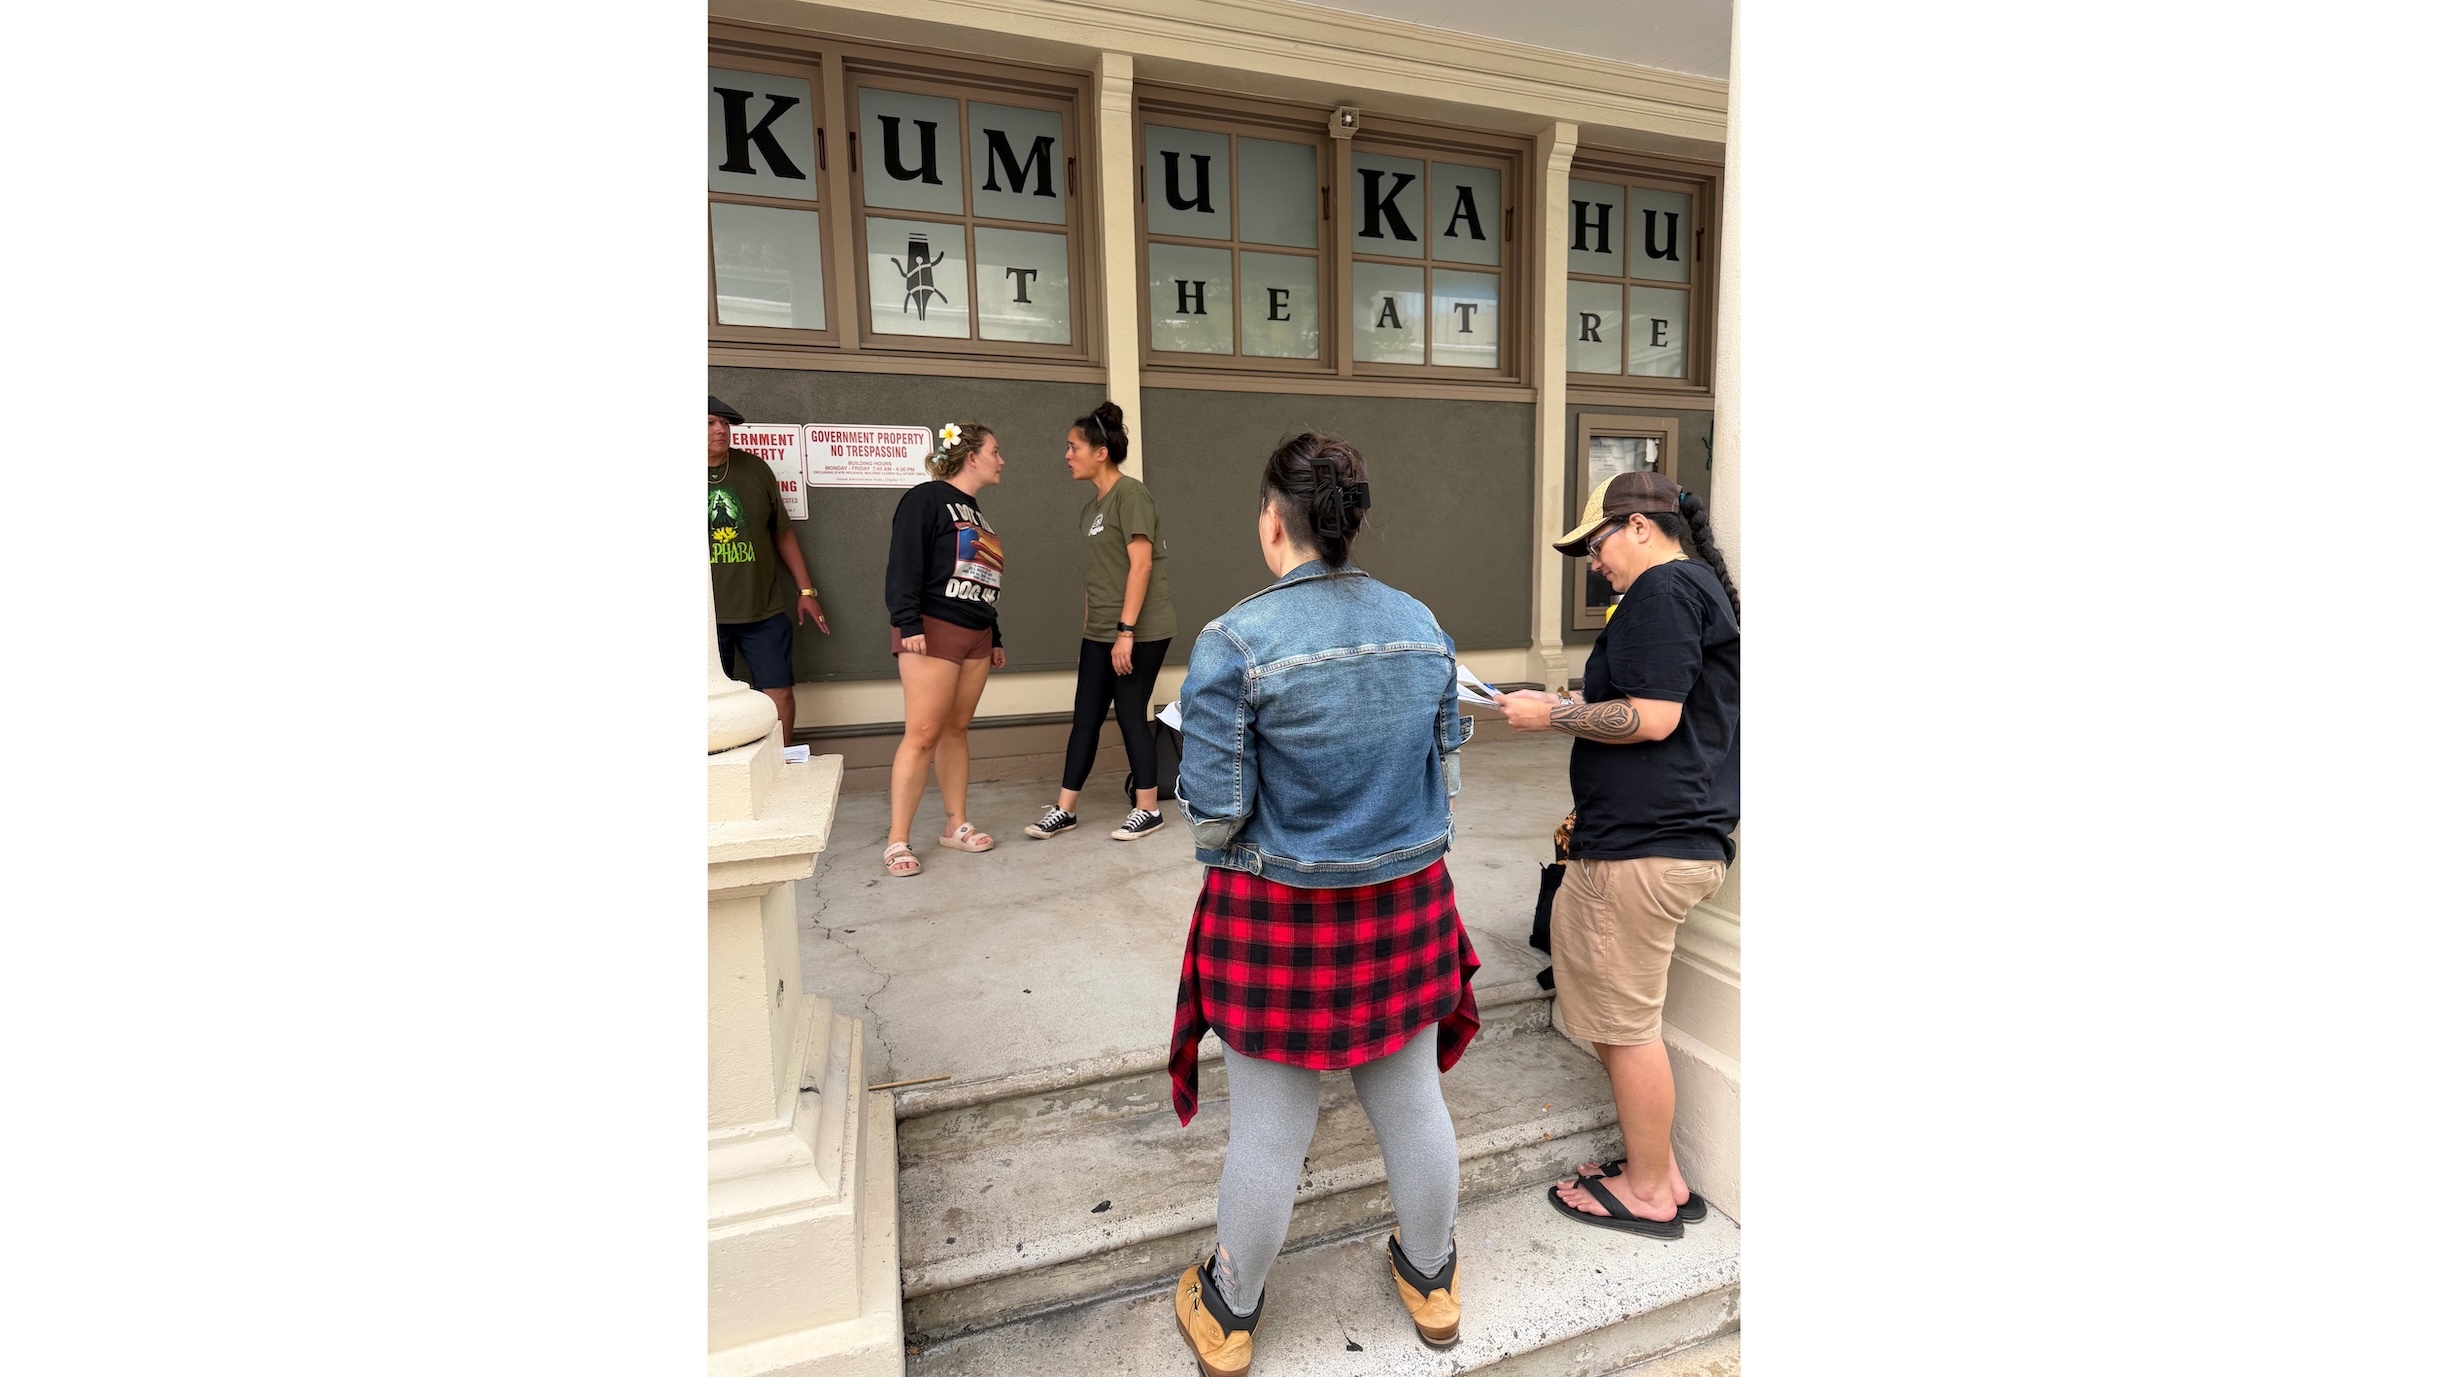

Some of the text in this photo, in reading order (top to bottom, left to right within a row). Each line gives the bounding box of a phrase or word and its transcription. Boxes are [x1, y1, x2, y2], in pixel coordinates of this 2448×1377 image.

[1006, 266, 1669, 348] THEATRE
[811, 430, 924, 445] GOVERNMENT PROPERTY
[830, 444, 908, 458] NO TRESPASSING
[945, 503, 959, 522] I
[945, 578, 981, 602] DOG
